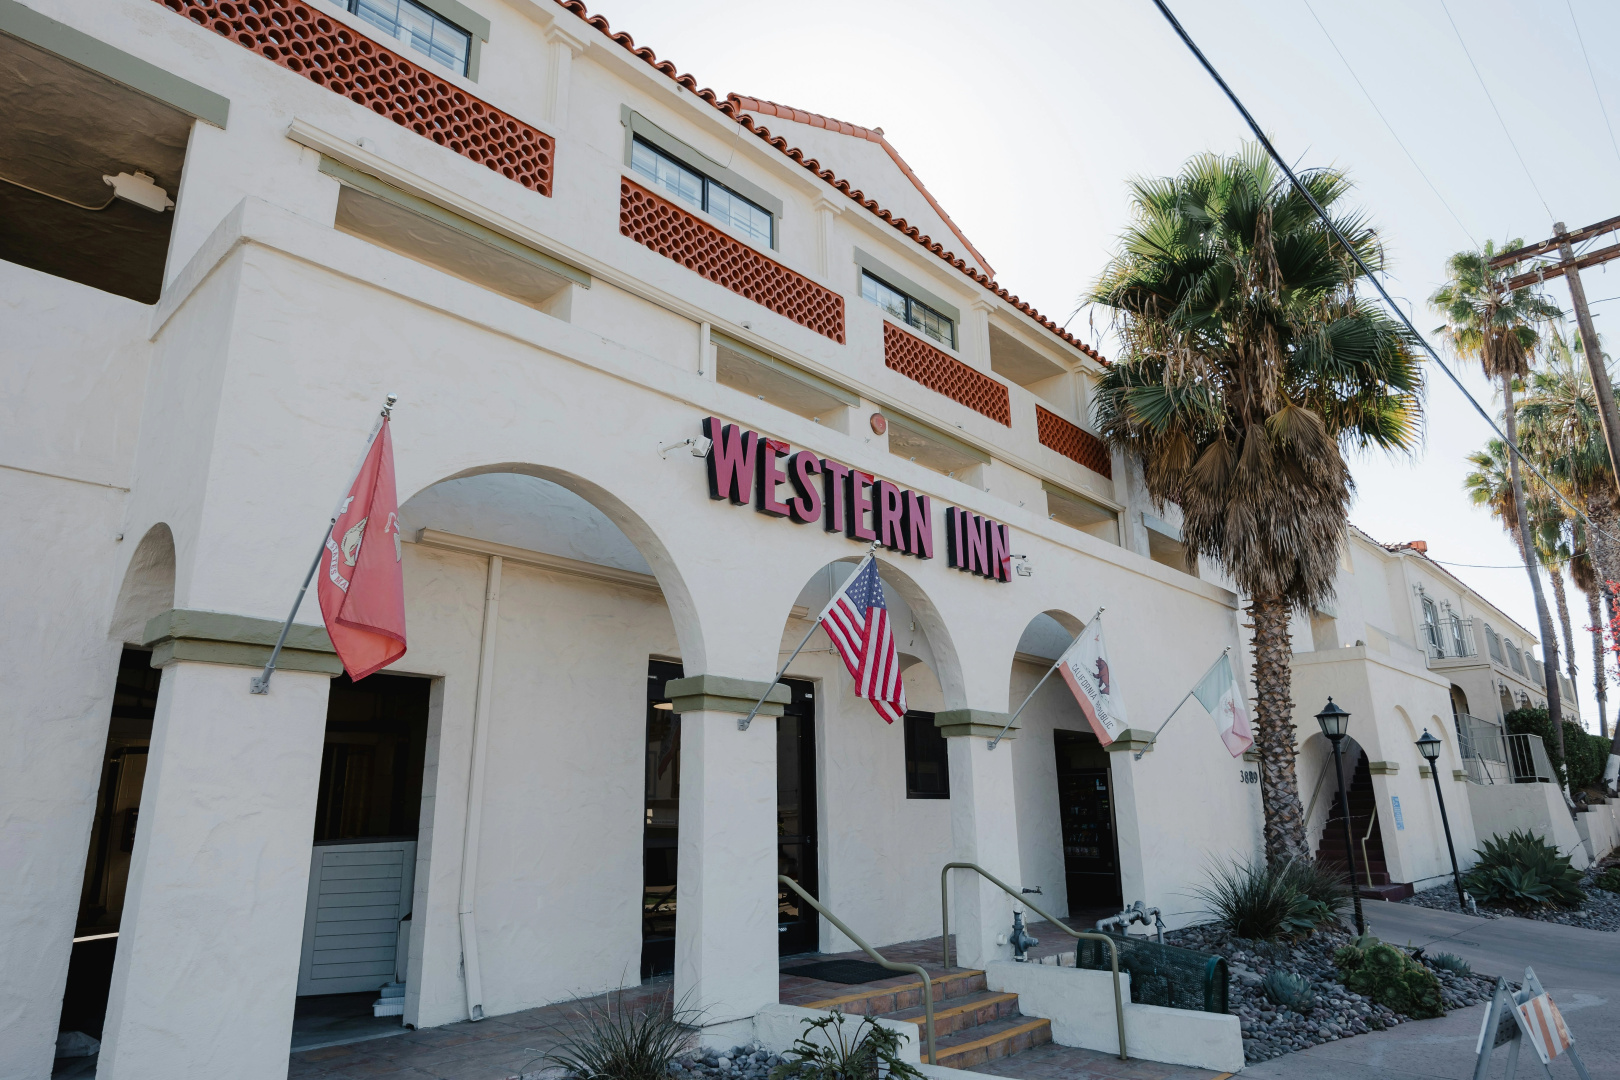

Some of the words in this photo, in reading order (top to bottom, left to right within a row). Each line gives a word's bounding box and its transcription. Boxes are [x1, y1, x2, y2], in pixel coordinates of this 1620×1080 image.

[702, 416, 933, 560] WESTERN
[946, 506, 1012, 583] INN
[330, 542, 338, 576] STATES
[1071, 663, 1098, 701] CALIFORNIA
[1240, 769, 1258, 785] 3889
